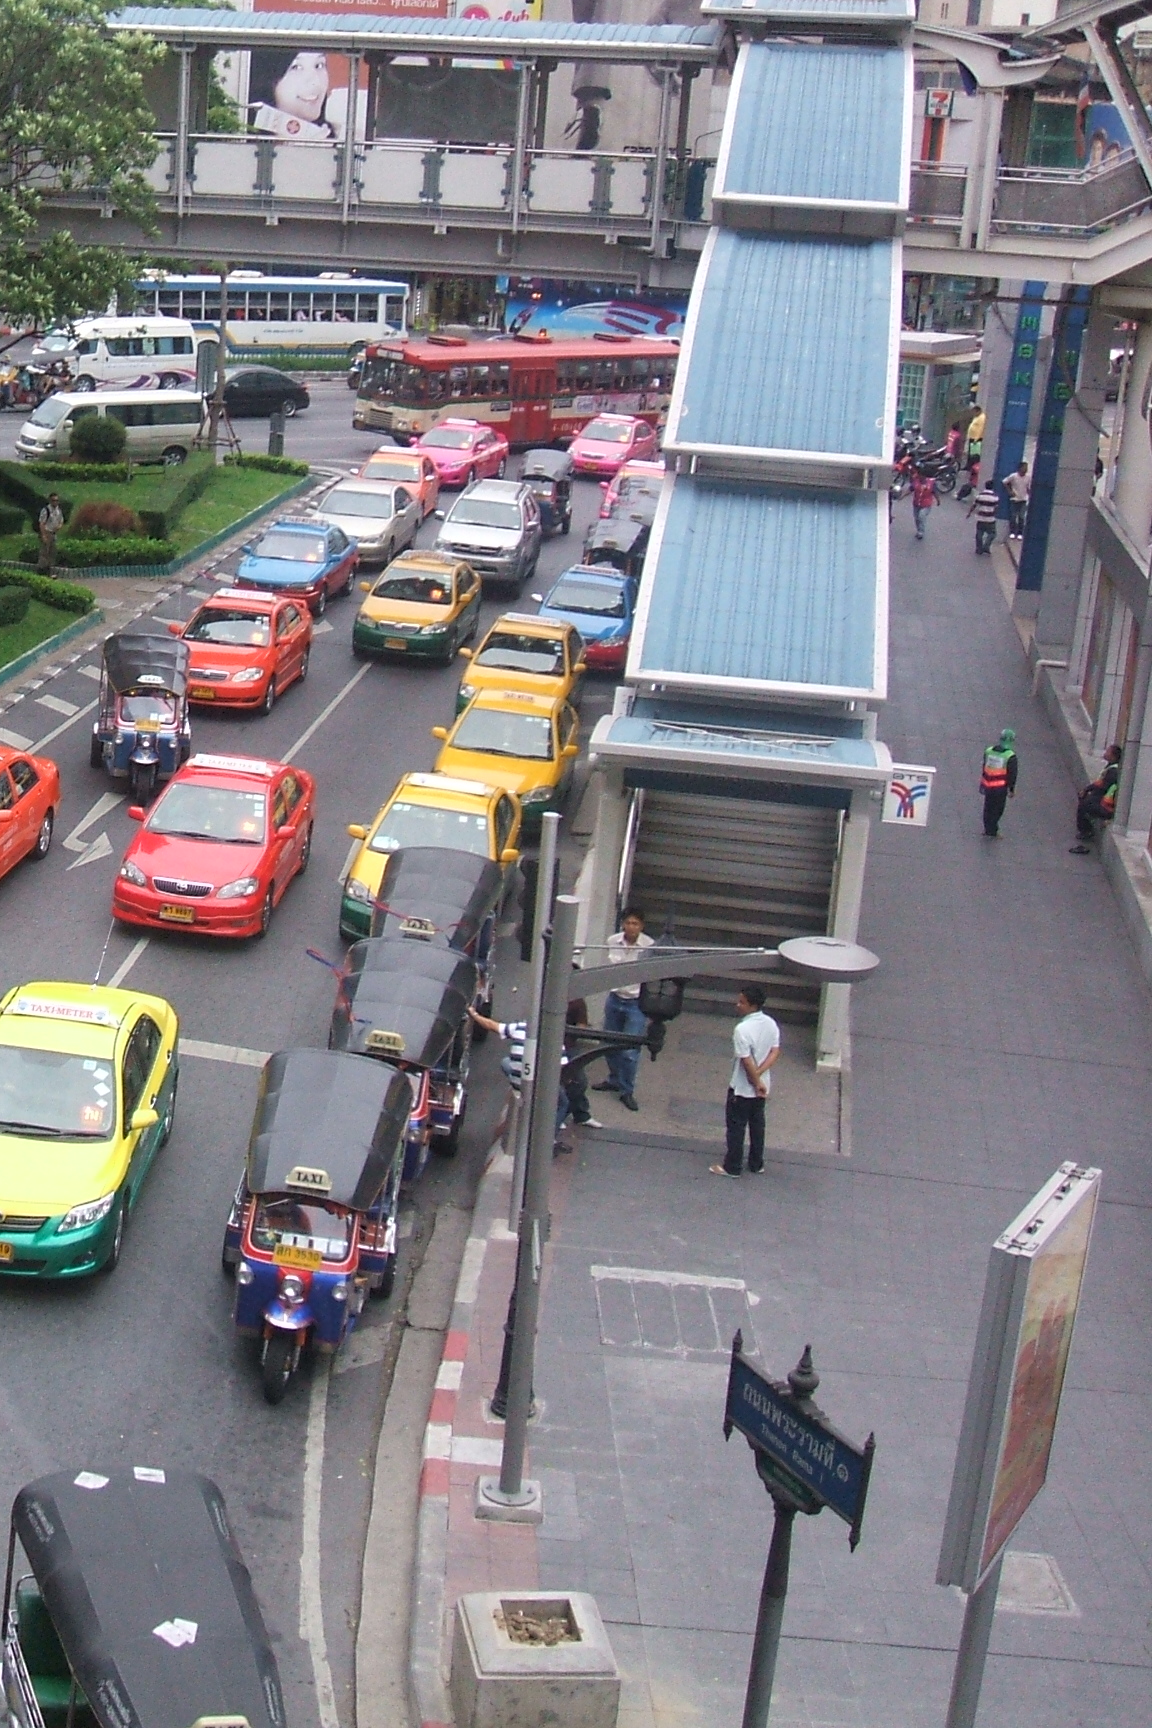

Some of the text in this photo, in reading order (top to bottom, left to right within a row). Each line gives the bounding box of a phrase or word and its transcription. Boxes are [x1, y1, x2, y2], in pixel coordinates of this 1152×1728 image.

[30, 1003, 94, 1019] TAXI-METER
[374, 1034, 396, 1045] TAXI
[524, 1063, 531, 1075] 5
[296, 1171, 323, 1184] TAXI
[743, 1383, 835, 1470] ถนนพระรามที่
[792, 1449, 813, 1475] Rama
